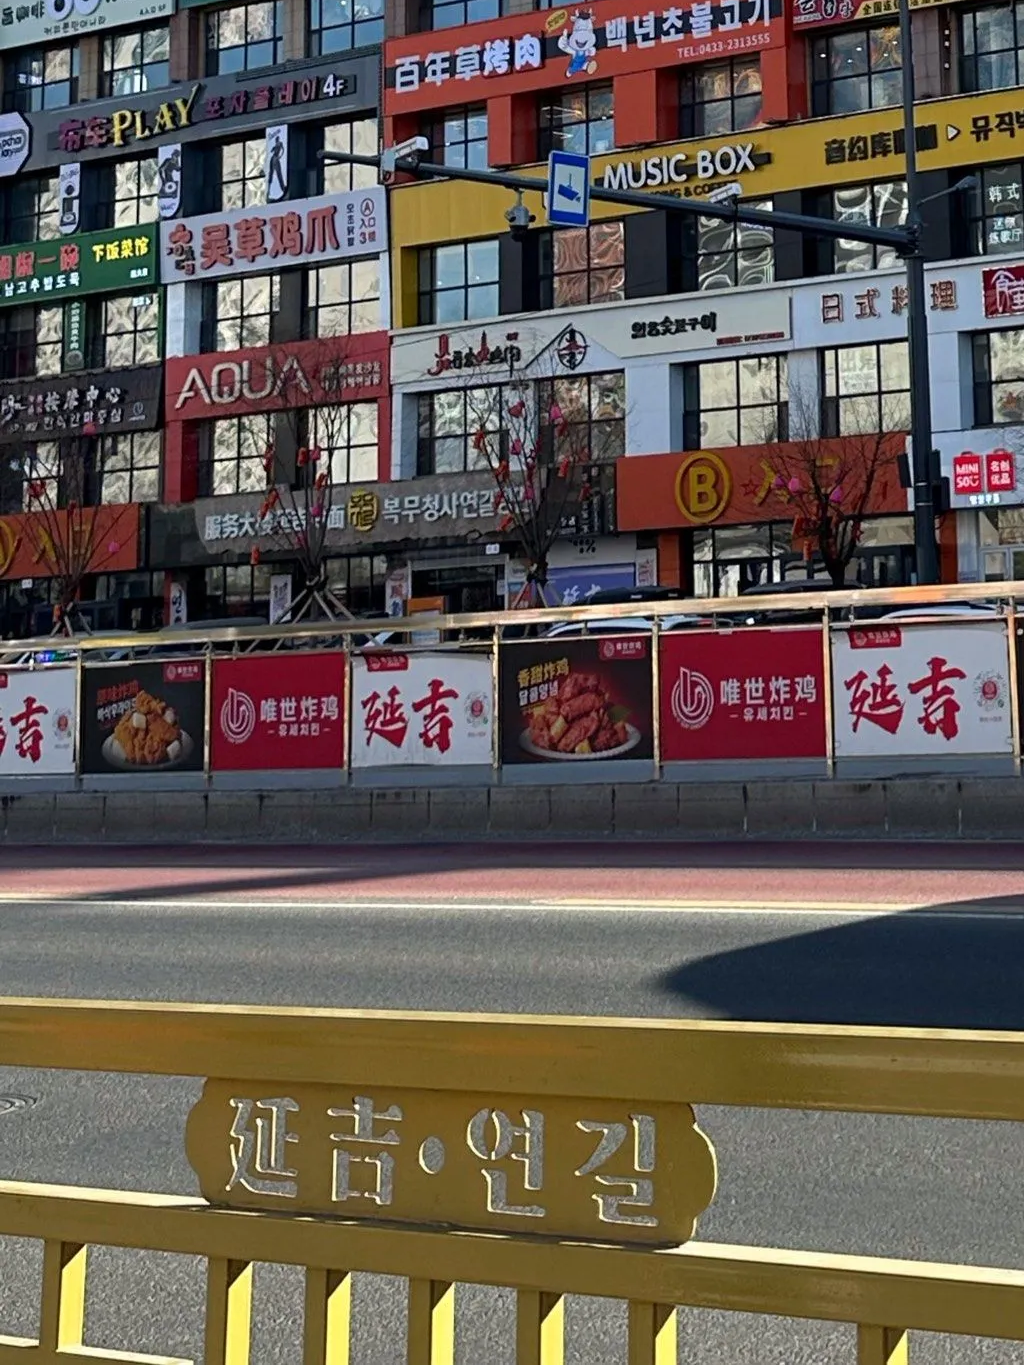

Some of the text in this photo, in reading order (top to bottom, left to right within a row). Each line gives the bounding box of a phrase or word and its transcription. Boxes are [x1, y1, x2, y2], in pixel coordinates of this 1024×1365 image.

[394, 33, 542, 93] 百年草烤肉
[322, 73, 345, 98] 4F
[602, 151, 688, 191] MUSIC
[696, 142, 756, 180] BOX
[92, 237, 150, 263] 下饭菜馆
[956, 462, 979, 474] MINI
[517, 657, 570, 688] 香甜炸鸡
[518, 680, 559, 707] 달콤양념
[719, 674, 818, 707] 唯世炸鸡
[845, 656, 968, 741] 延吉
[260, 695, 339, 723] 唯世炸鸡
[361, 679, 459, 755] 延吉
[742, 707, 795, 723] 유세치킨
